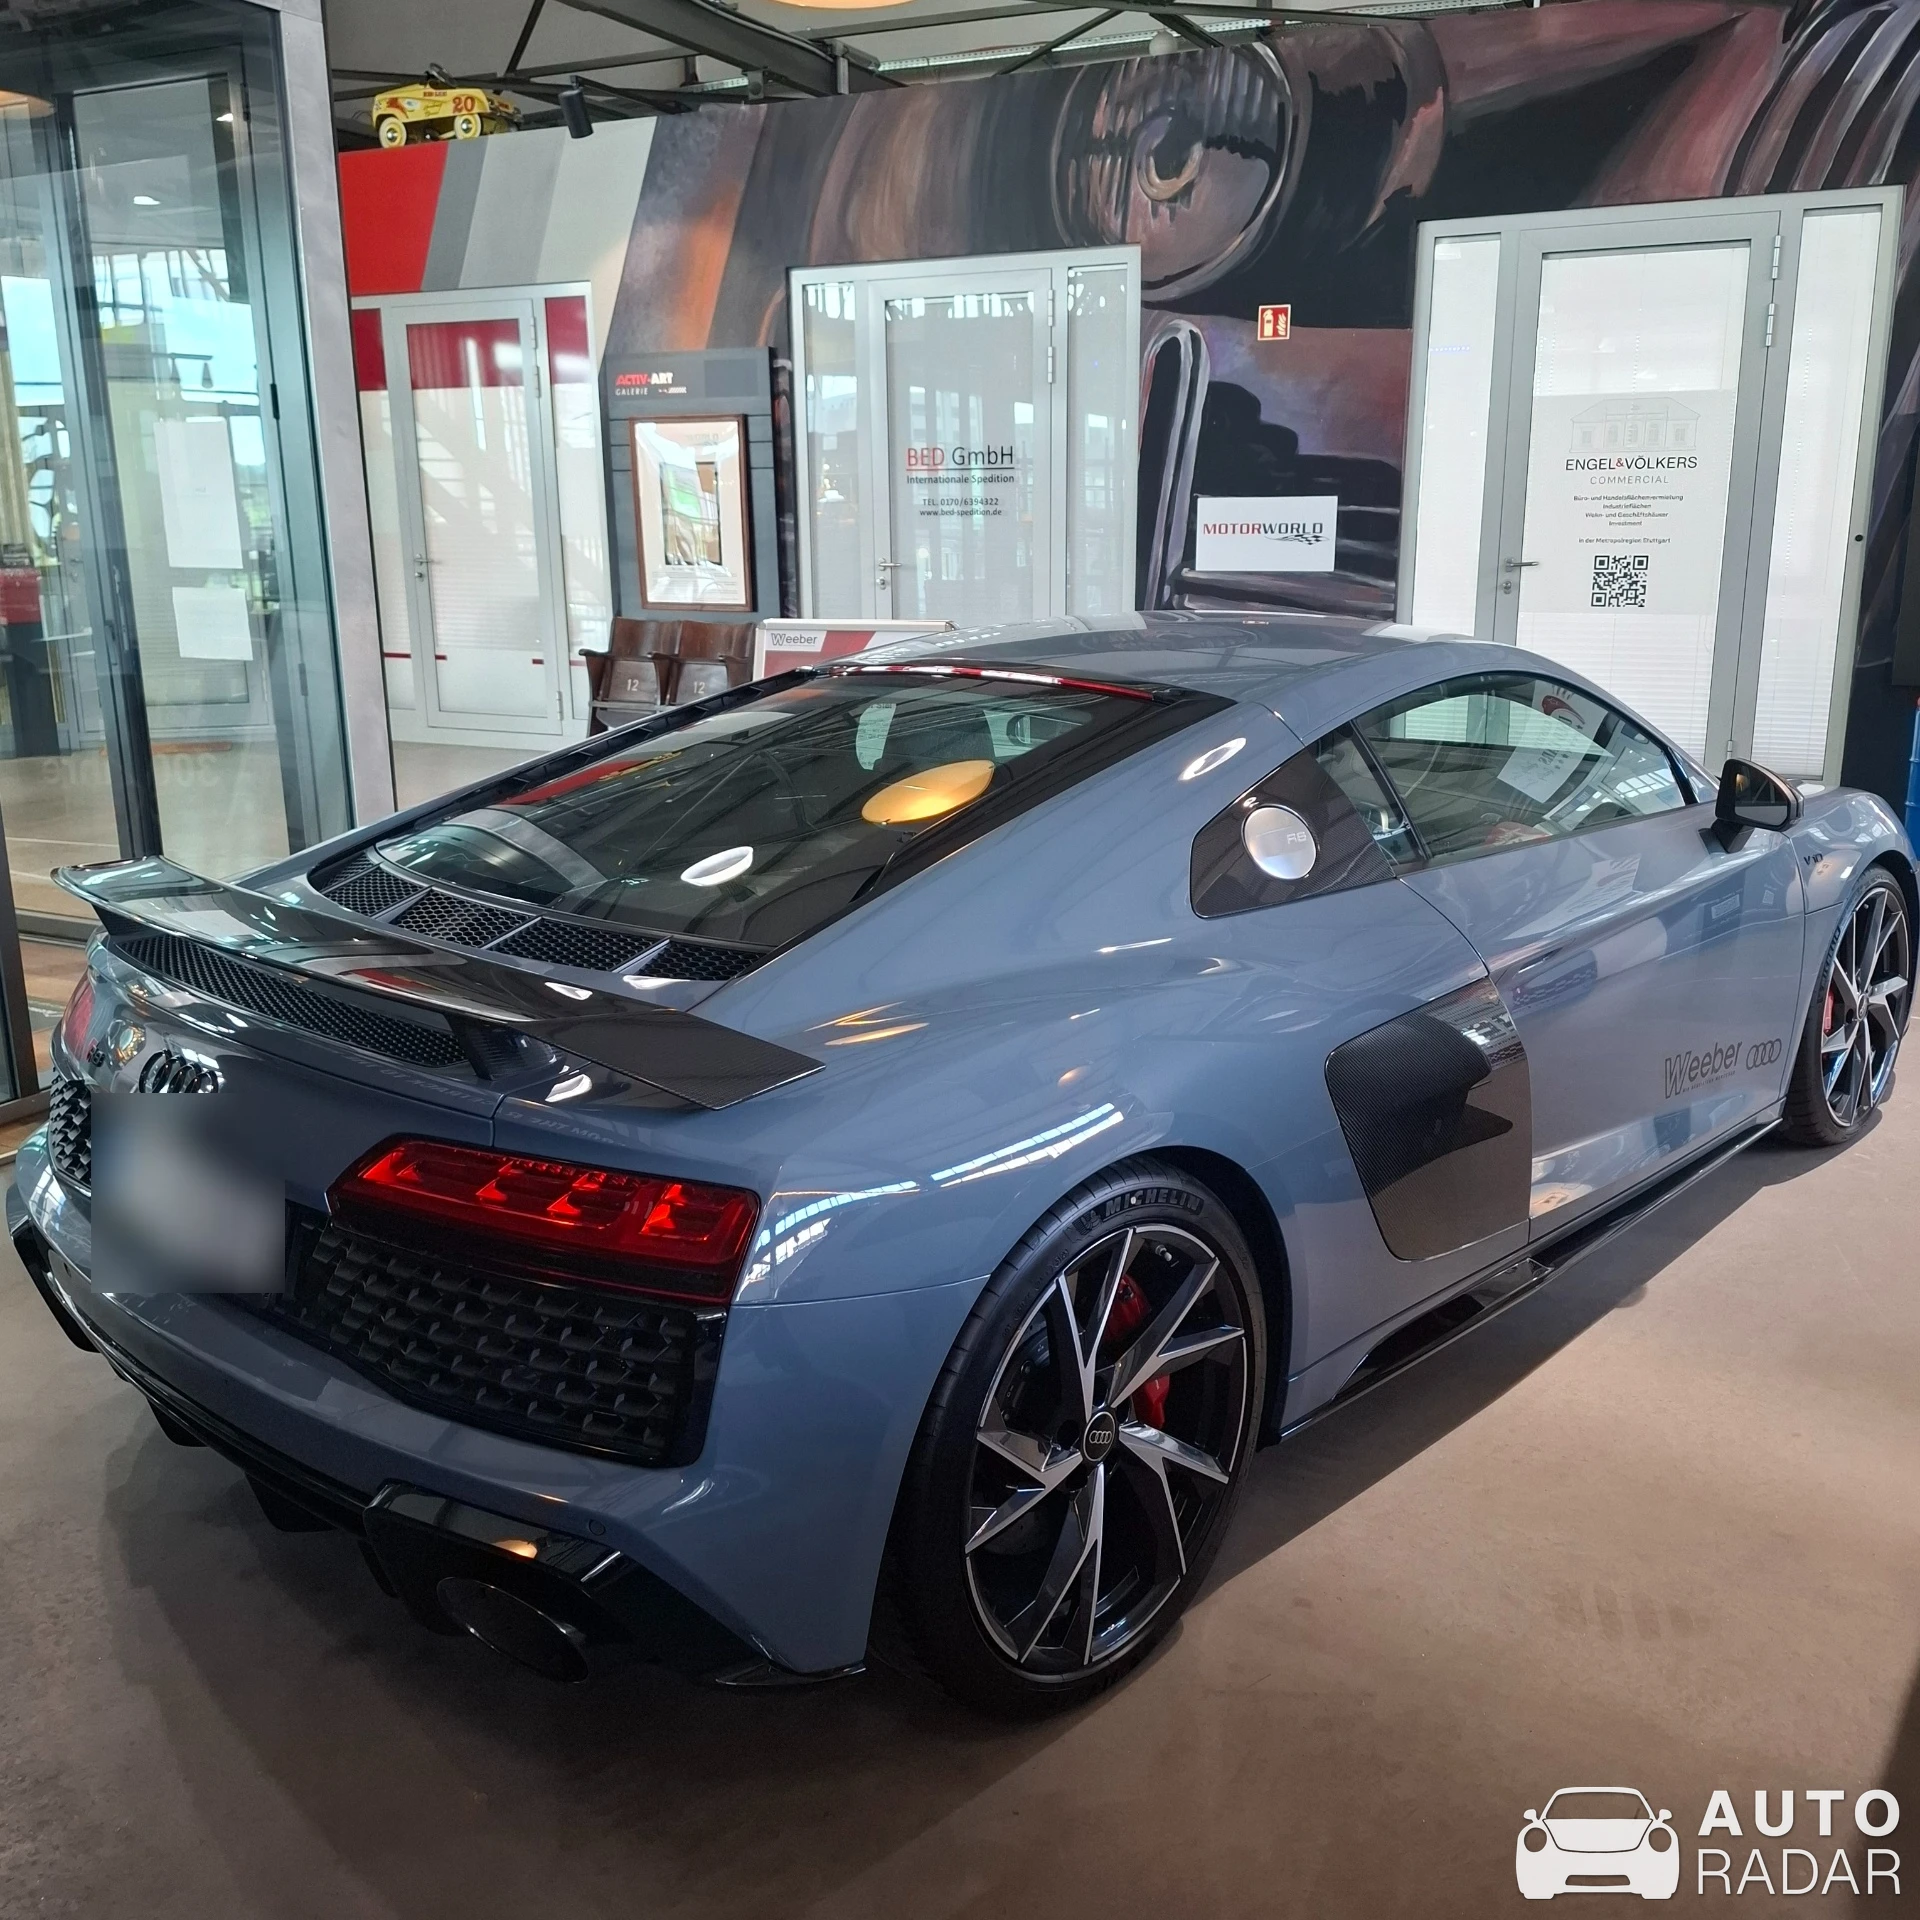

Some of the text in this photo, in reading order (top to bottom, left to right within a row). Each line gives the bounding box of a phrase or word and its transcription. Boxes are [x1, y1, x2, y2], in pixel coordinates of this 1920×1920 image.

[452, 94, 476, 114] 20
[615, 387, 649, 396] GALERIE
[907, 445, 1014, 466] BED GmbH
[1565, 455, 1698, 471] ENGEL&VÖLKERS
[906, 474, 1015, 485] Internationale Spedition
[1590, 475, 1669, 485] COMMERCIAL
[922, 498, 999, 506] TEL. 0170/6394322
[919, 508, 1002, 517] www.bed-spedition.de
[1203, 522, 1324, 535] MOTORWORLD
[770, 632, 818, 646] Weeber
[627, 678, 640, 692] 12
[693, 681, 706, 694] 12
[1803, 852, 1824, 866] V10
[1664, 1041, 1743, 1099] Weeber
[1105, 1188, 1200, 1218] MICHELIN
